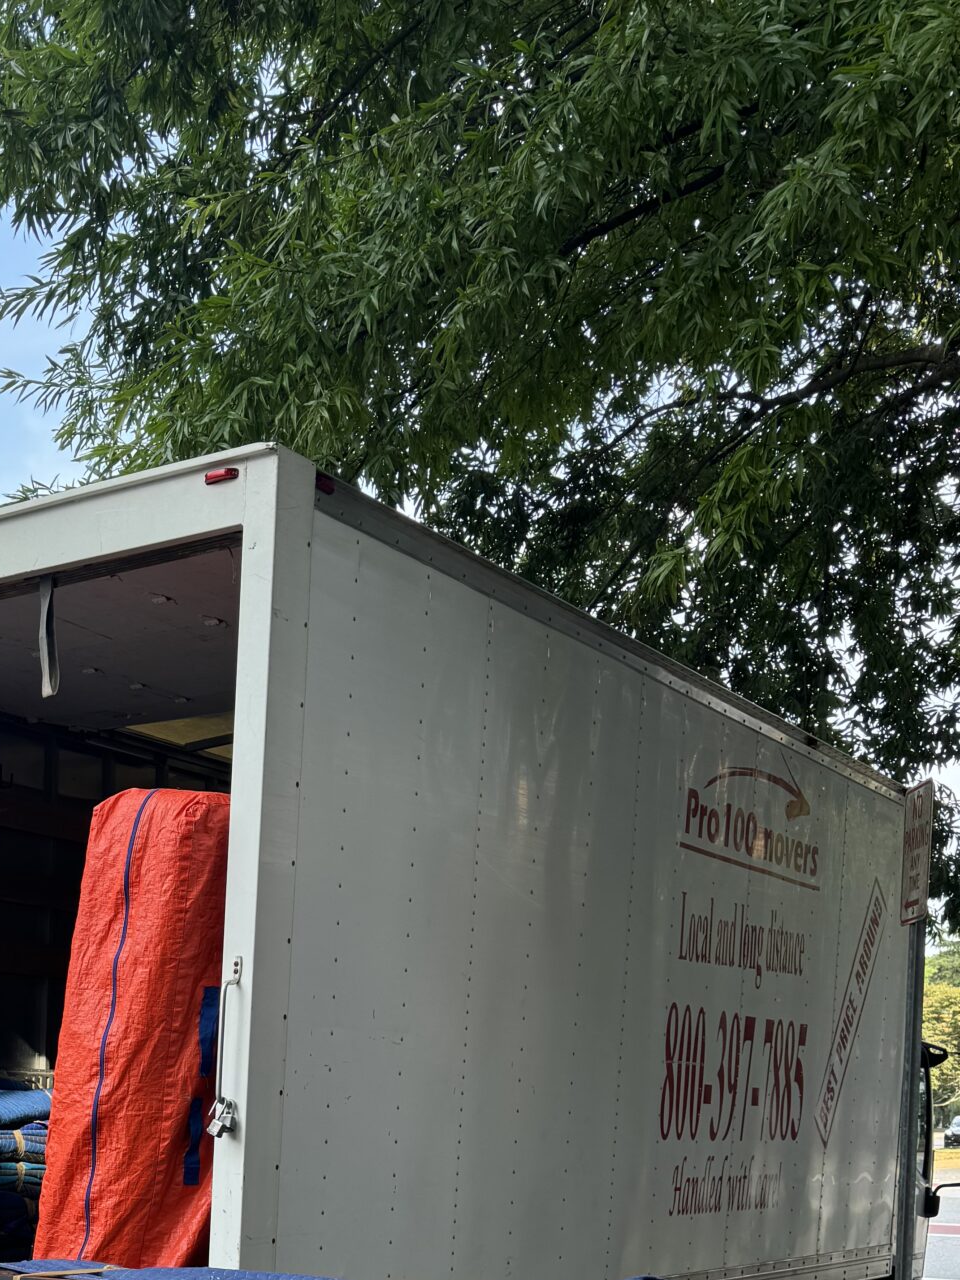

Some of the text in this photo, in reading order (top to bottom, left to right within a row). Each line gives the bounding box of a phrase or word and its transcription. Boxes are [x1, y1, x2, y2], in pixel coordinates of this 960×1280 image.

[912, 793, 923, 821] NO
[905, 819, 929, 855] PARKING
[908, 873, 921, 893] TIME
[910, 854, 920, 872] ANY
[678, 891, 805, 990] Local and long distance
[819, 896, 883, 1133] BEST PRICE AROUND
[659, 1001, 808, 1141] 800-397-7885
[669, 1155, 729, 1217] Handled
[727, 1155, 755, 1212] with
